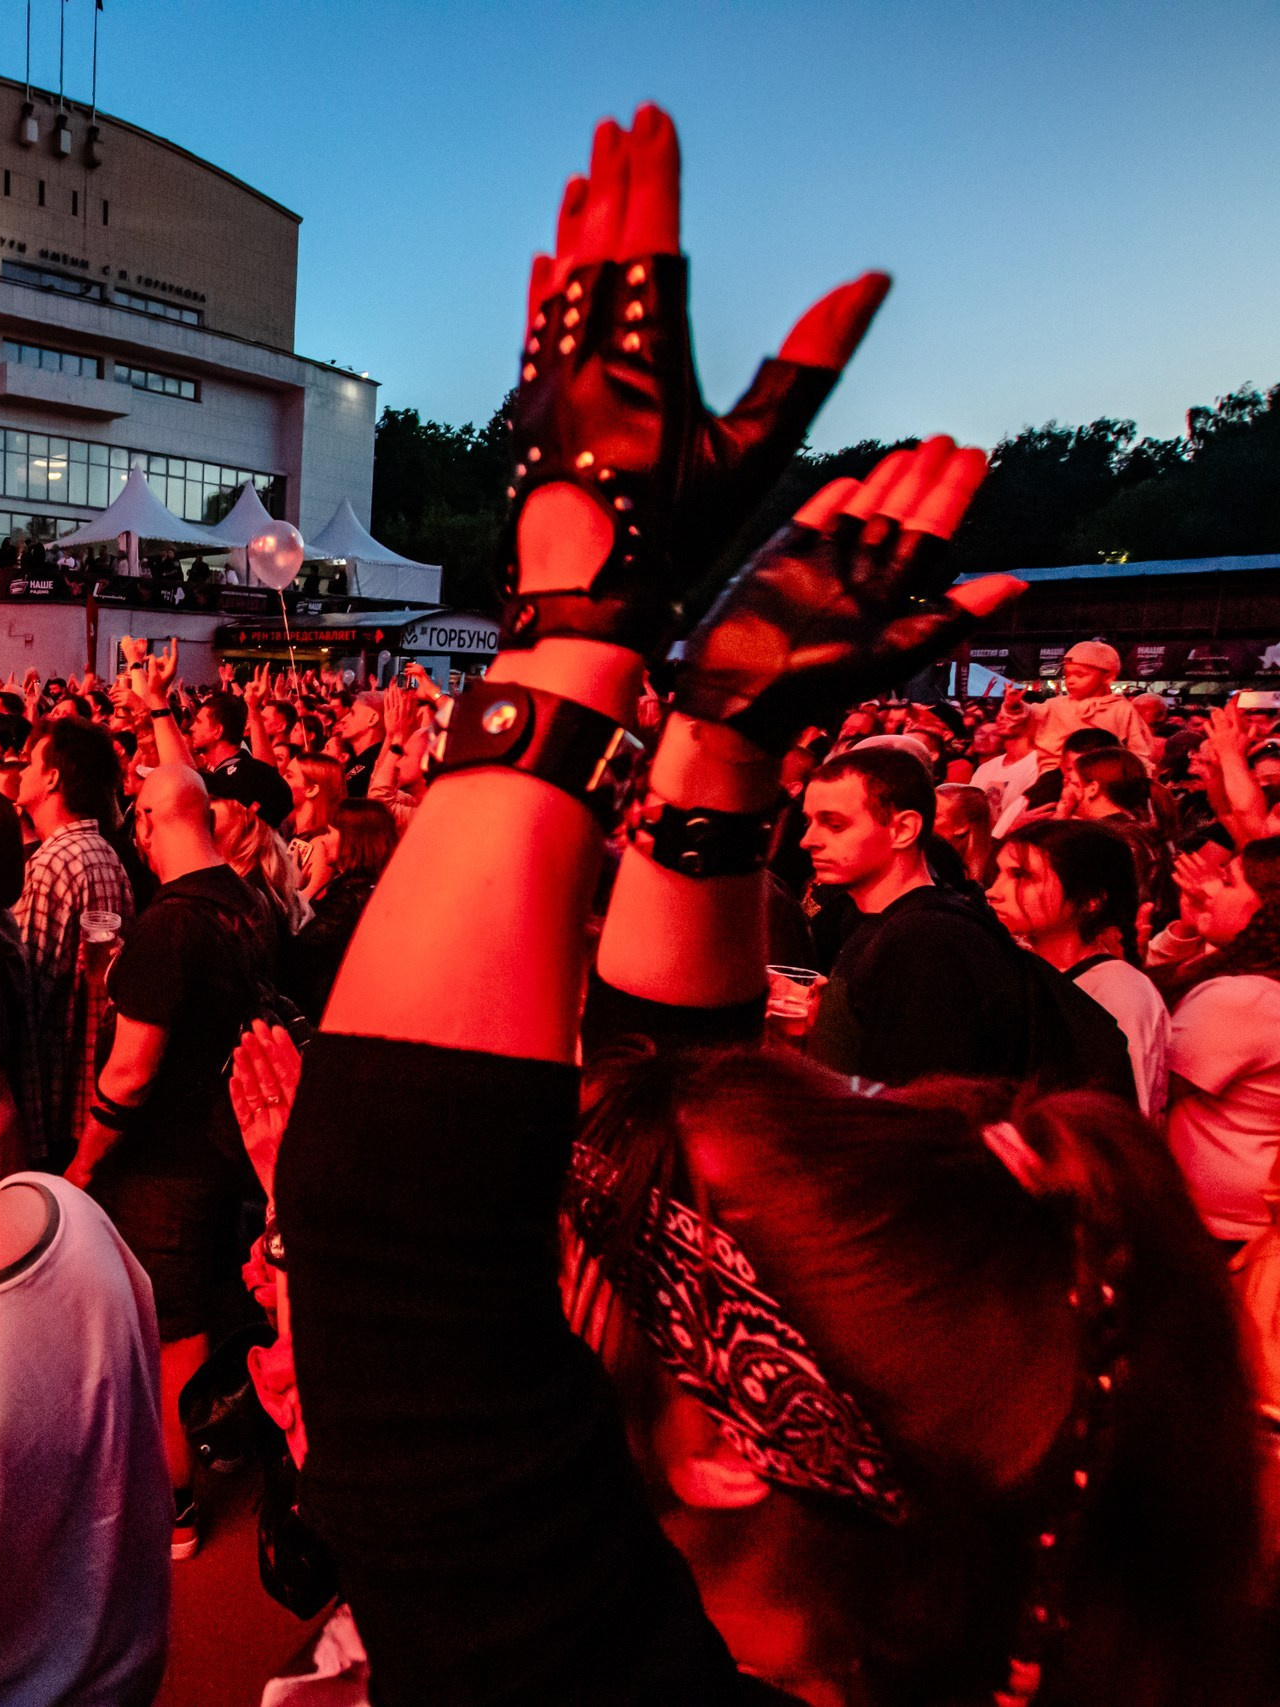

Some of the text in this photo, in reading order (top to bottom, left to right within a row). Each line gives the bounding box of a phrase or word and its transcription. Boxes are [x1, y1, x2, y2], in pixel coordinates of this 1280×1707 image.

[39, 248, 90, 270] ИМЕНИ
[136, 274, 207, 303] ГОРБУНОВА
[29, 580, 54, 590] НАШЕ
[251, 631, 268, 640] РЕН
[283, 630, 356, 642] ПРЕДСТАВЛЯЕТ
[428, 627, 497, 650] ГОРБУНО
